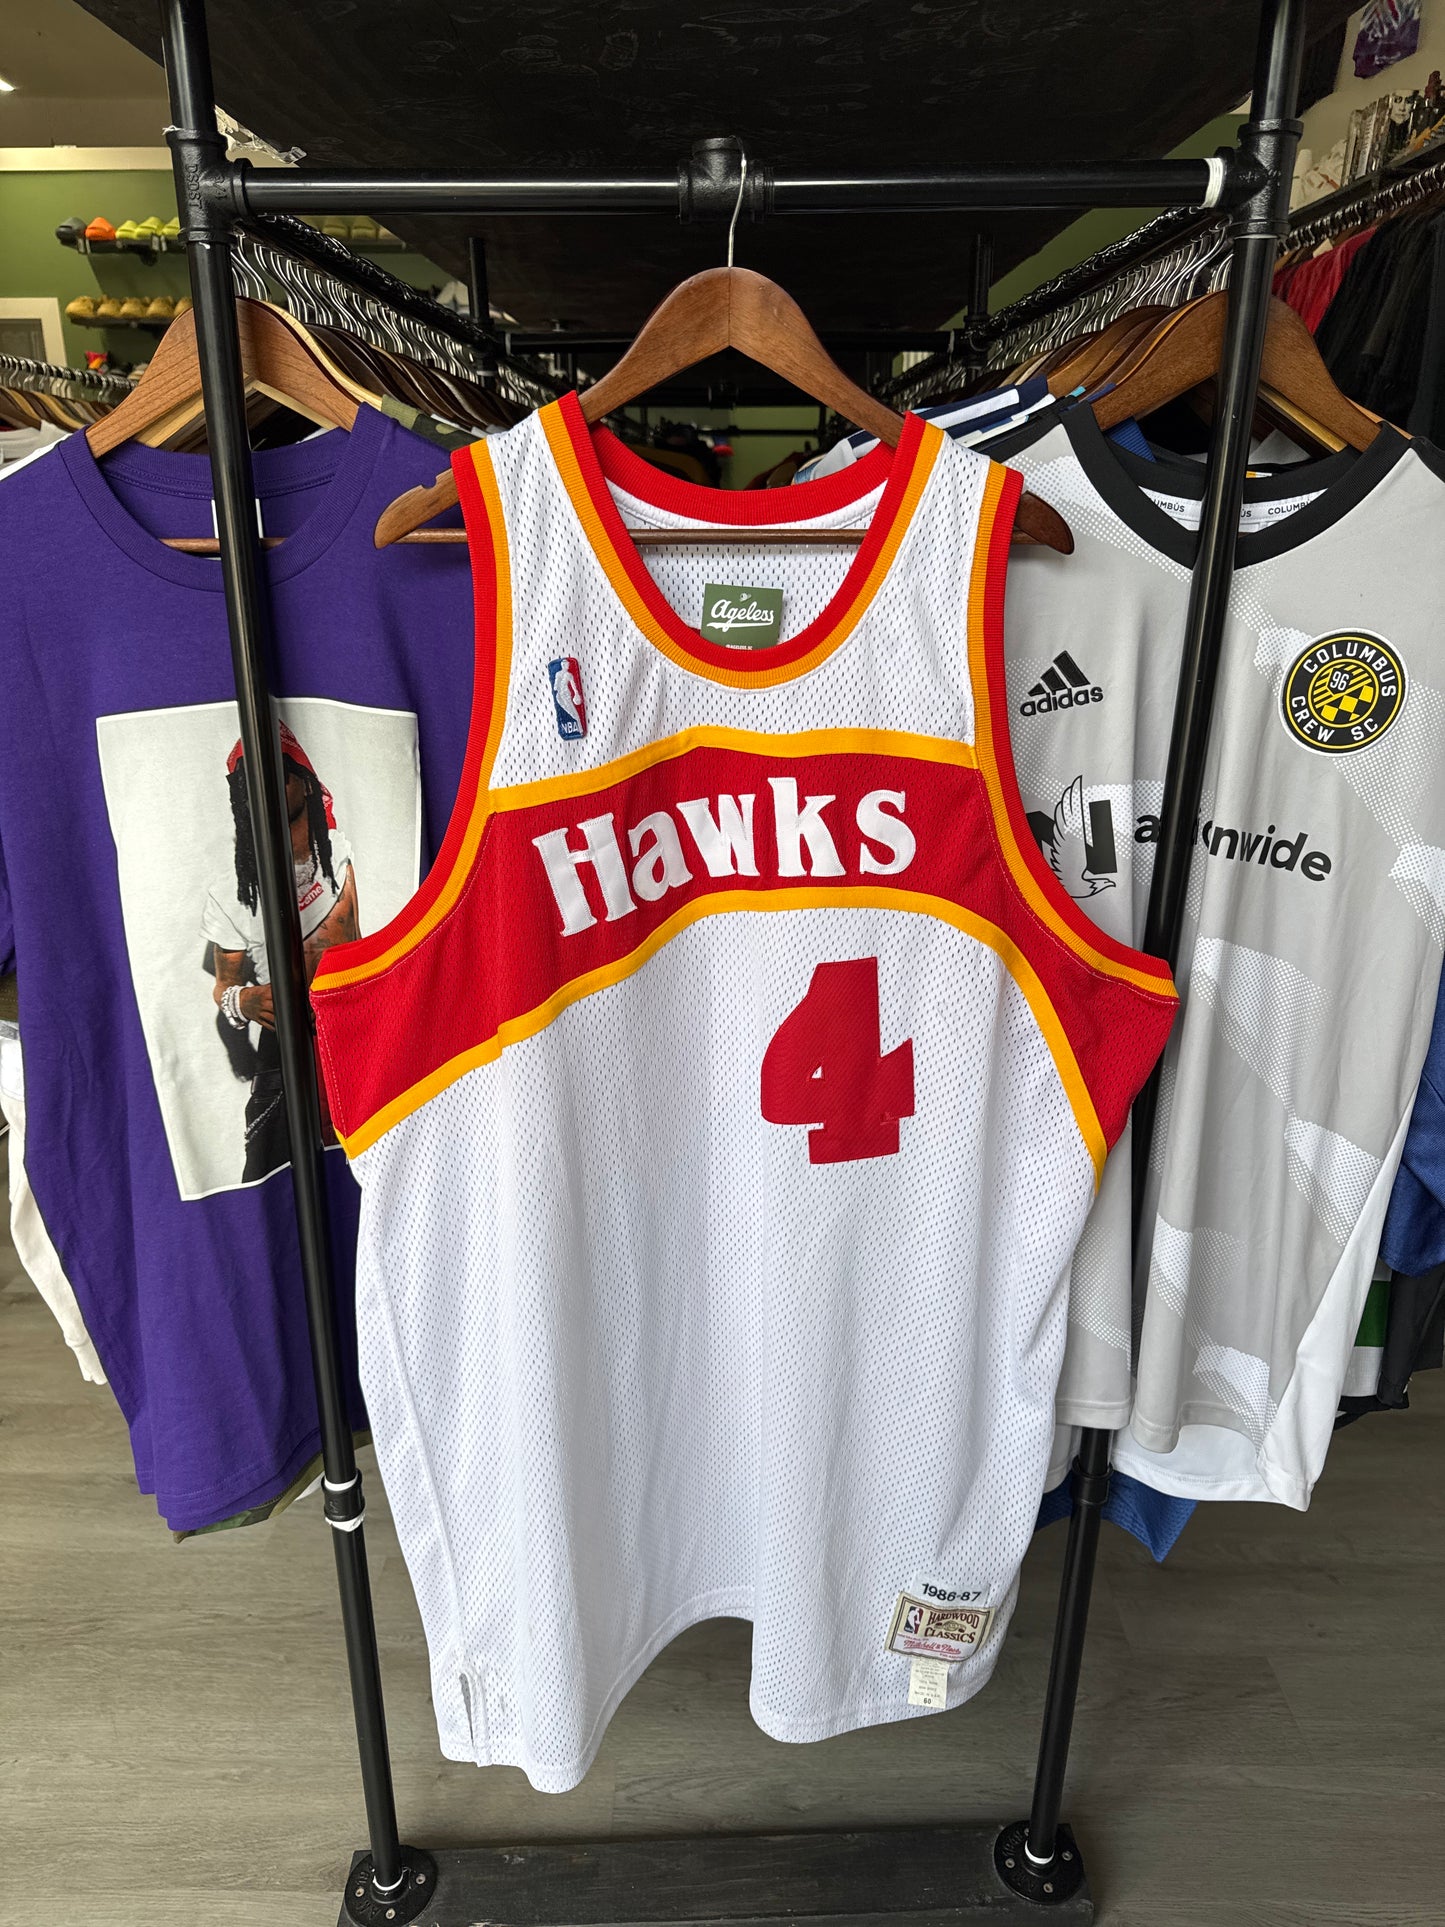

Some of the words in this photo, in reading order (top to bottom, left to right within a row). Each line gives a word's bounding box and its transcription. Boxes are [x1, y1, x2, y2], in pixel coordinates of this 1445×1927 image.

[709, 598, 774, 632] Ageless
[1303, 642, 1396, 697] COLUMBUS
[1329, 670, 1350, 691] 96
[1019, 686, 1104, 717] adidas
[561, 721, 578, 734] NBA
[1291, 695, 1336, 743] CREW
[1350, 717, 1379, 742] SC
[532, 776, 917, 937] Hawks
[760, 956, 915, 1165] 4
[921, 1583, 981, 1602] 1986-87
[926, 1610, 980, 1629] HARDWOOD
[924, 1626, 975, 1644] CLASSICS
[923, 1697, 932, 1705] 60
